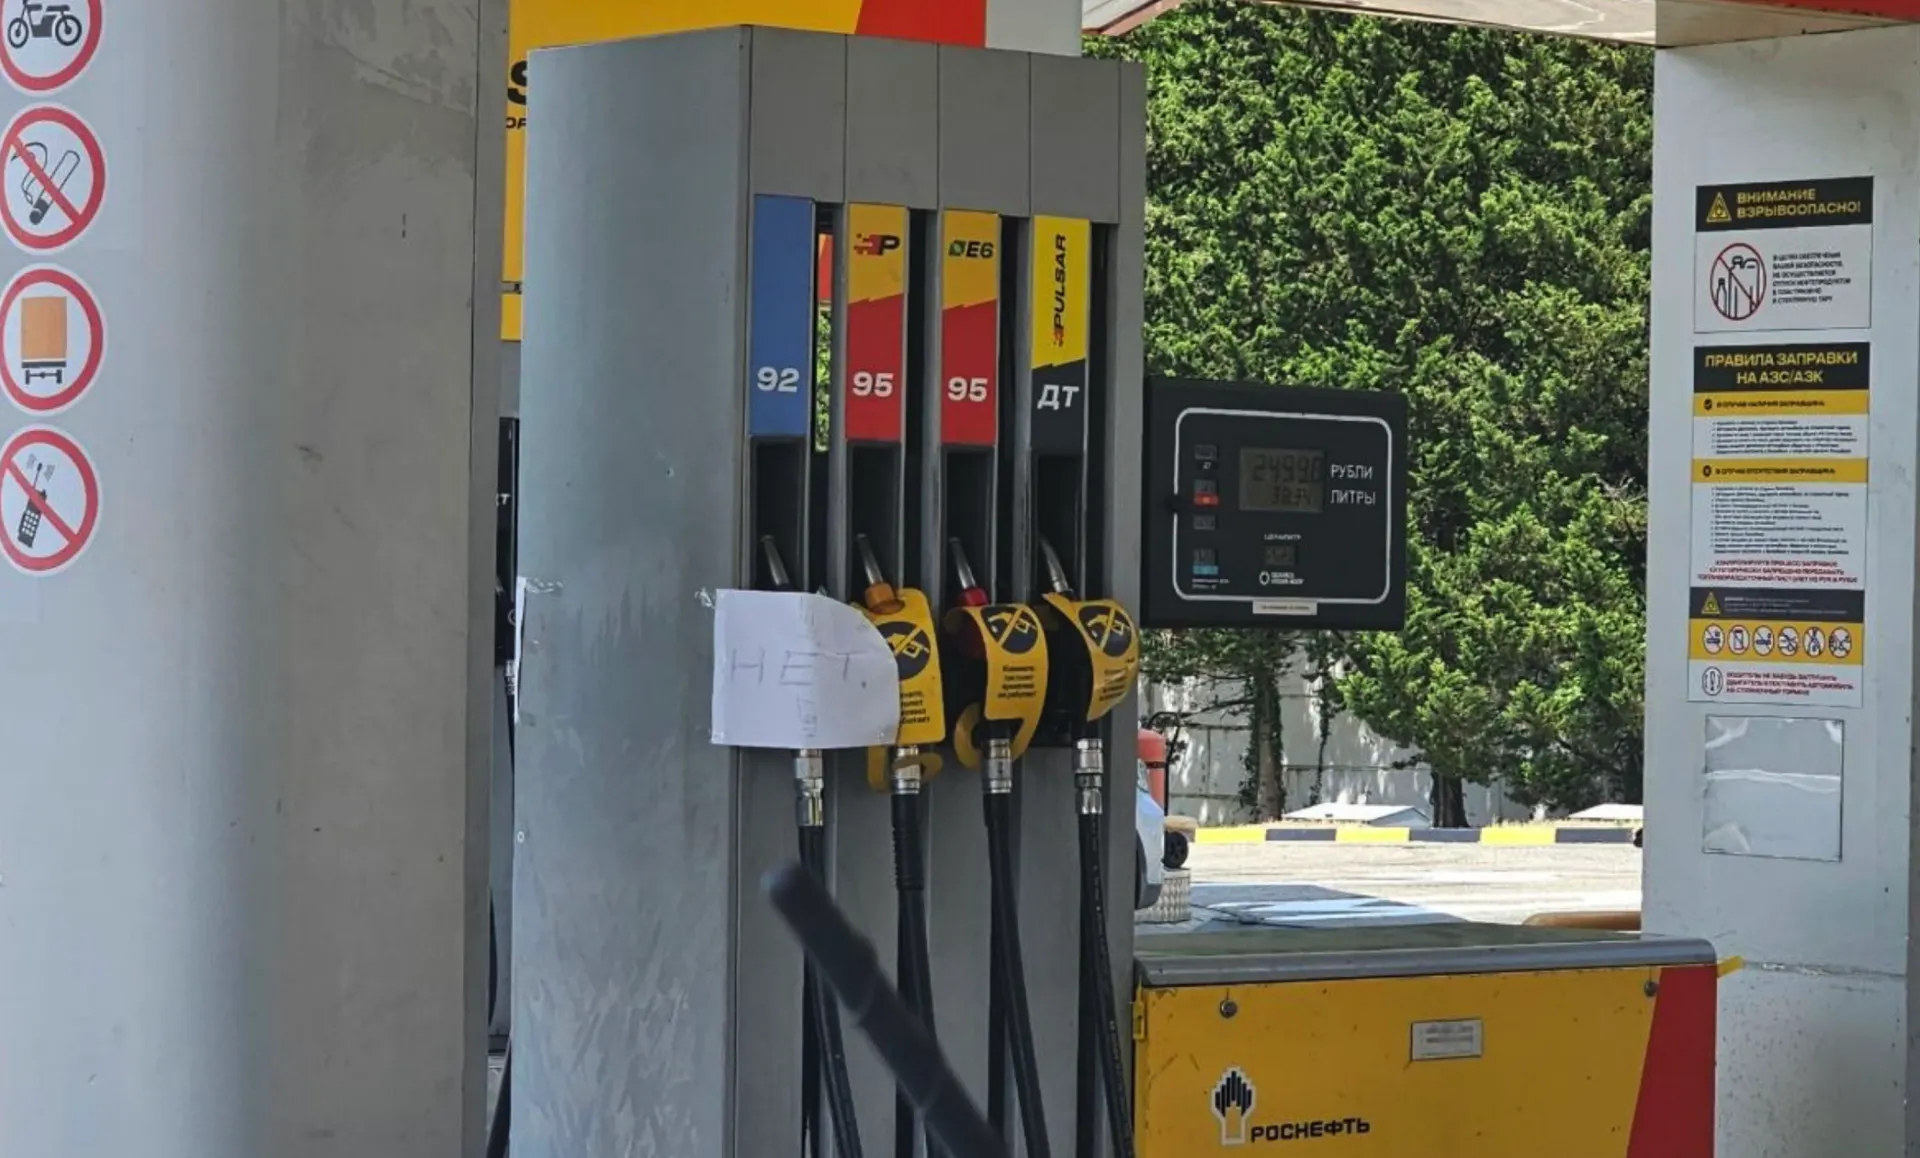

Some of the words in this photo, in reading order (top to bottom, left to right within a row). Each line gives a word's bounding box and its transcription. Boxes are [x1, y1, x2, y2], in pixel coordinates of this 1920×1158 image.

[1737, 188, 1816, 204] ВНИМАНИЕ
[1737, 201, 1861, 219] ВЗРЫВООПАСНО!
[1054, 234, 1067, 330] PULSAR
[1705, 354, 1775, 367] ПРАВИЛА
[1777, 352, 1858, 366] ЗАПРАВКИ
[757, 367, 799, 393] 92
[853, 372, 893, 397] 95
[1737, 372, 1757, 384] НА
[1759, 370, 1823, 384] АЗС/АЗК
[948, 377, 988, 402] 95
[1037, 384, 1079, 410] ДТ
[1331, 464, 1373, 479] РУБЛИ
[1331, 489, 1376, 506] ЛИТРЫ
[732, 649, 868, 685] НЕТ
[1251, 1118, 1370, 1142] РОСНЕФТЬ
